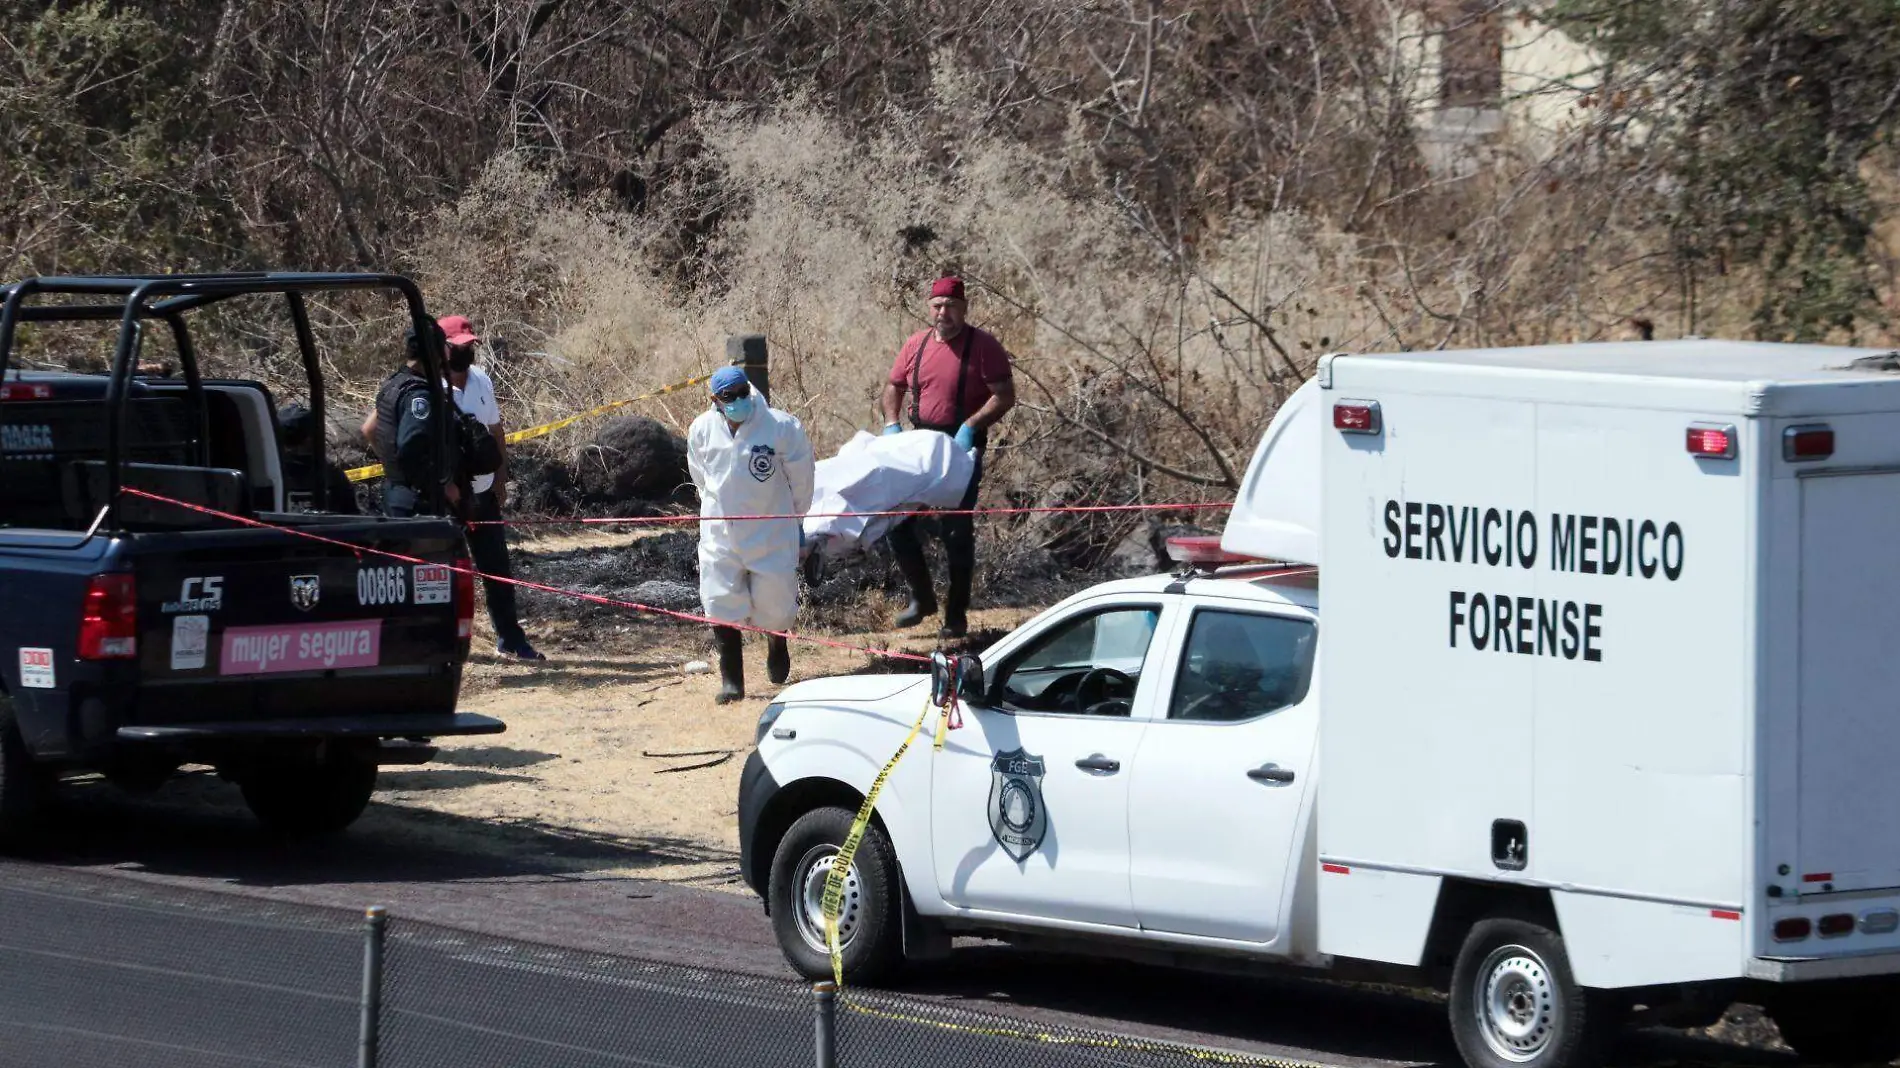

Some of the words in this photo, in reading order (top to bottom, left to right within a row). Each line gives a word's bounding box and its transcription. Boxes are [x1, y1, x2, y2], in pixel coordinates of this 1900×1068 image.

[1383, 500, 1538, 570] SERVICIO
[1551, 513, 1685, 582] MEDICO
[181, 576, 224, 603] C5
[357, 566, 406, 606] 00866
[417, 568, 447, 581] 911
[1449, 591, 1603, 662] FORENSE
[231, 634, 291, 670] mujer
[298, 629, 371, 667] segura
[1008, 760, 1029, 774] FGE
